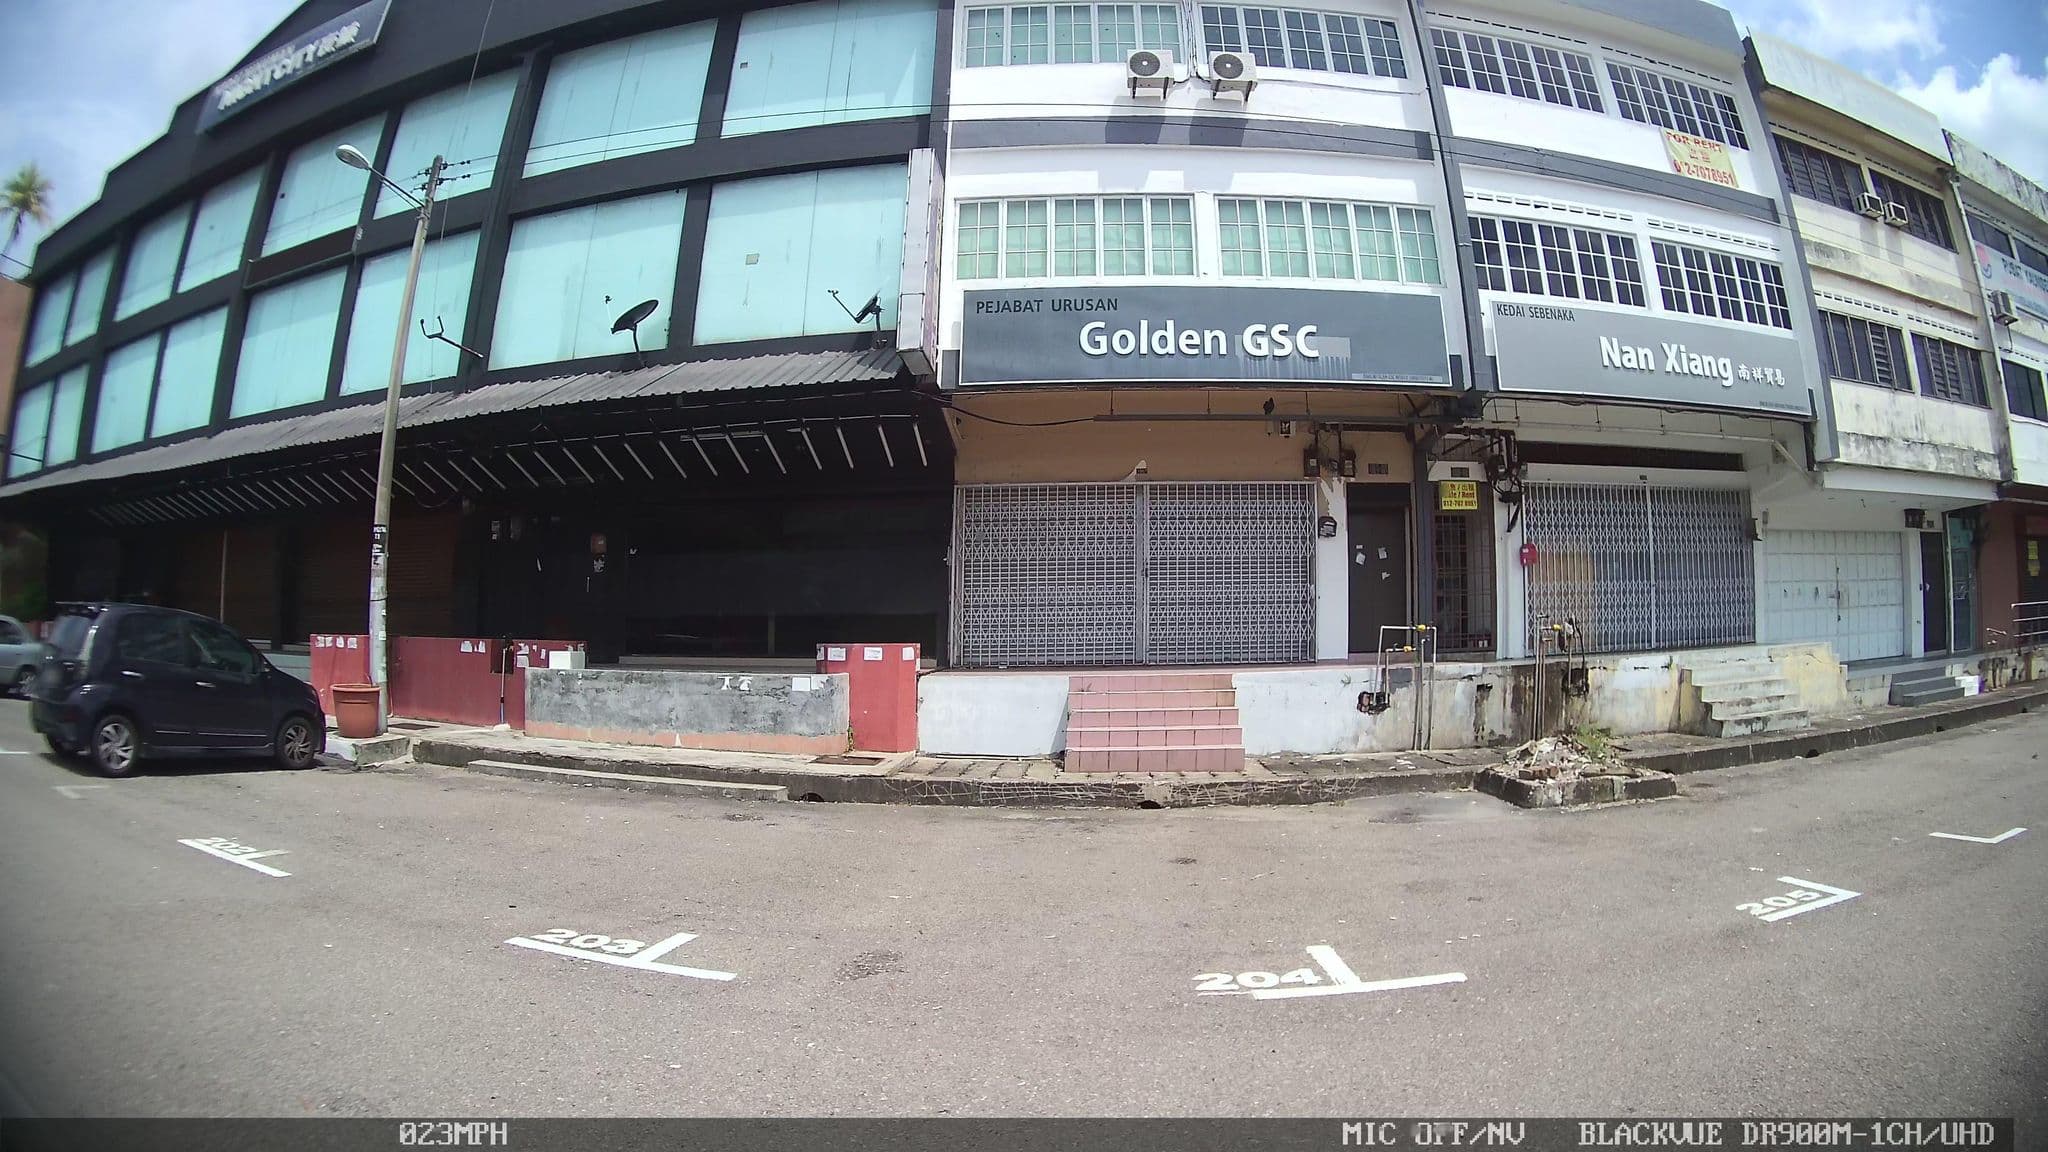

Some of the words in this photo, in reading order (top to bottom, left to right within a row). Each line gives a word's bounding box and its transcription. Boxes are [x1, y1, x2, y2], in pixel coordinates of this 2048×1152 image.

[1666, 131, 1691, 145] FOR
[1693, 138, 1723, 153] RENT
[976, 299, 1043, 314] PEJABAT
[1051, 298, 1118, 312] URUSAN
[1496, 304, 1526, 318] KEDAI
[1529, 306, 1576, 322] SEBENAKA
[1079, 319, 1228, 357] Golden
[1242, 323, 1320, 358] GSC
[1600, 336, 1656, 371] Nan
[1661, 342, 1734, 388] Xiang
[1736, 889, 1821, 917] 205
[530, 928, 646, 954] 203
[1192, 967, 1324, 991] 204
